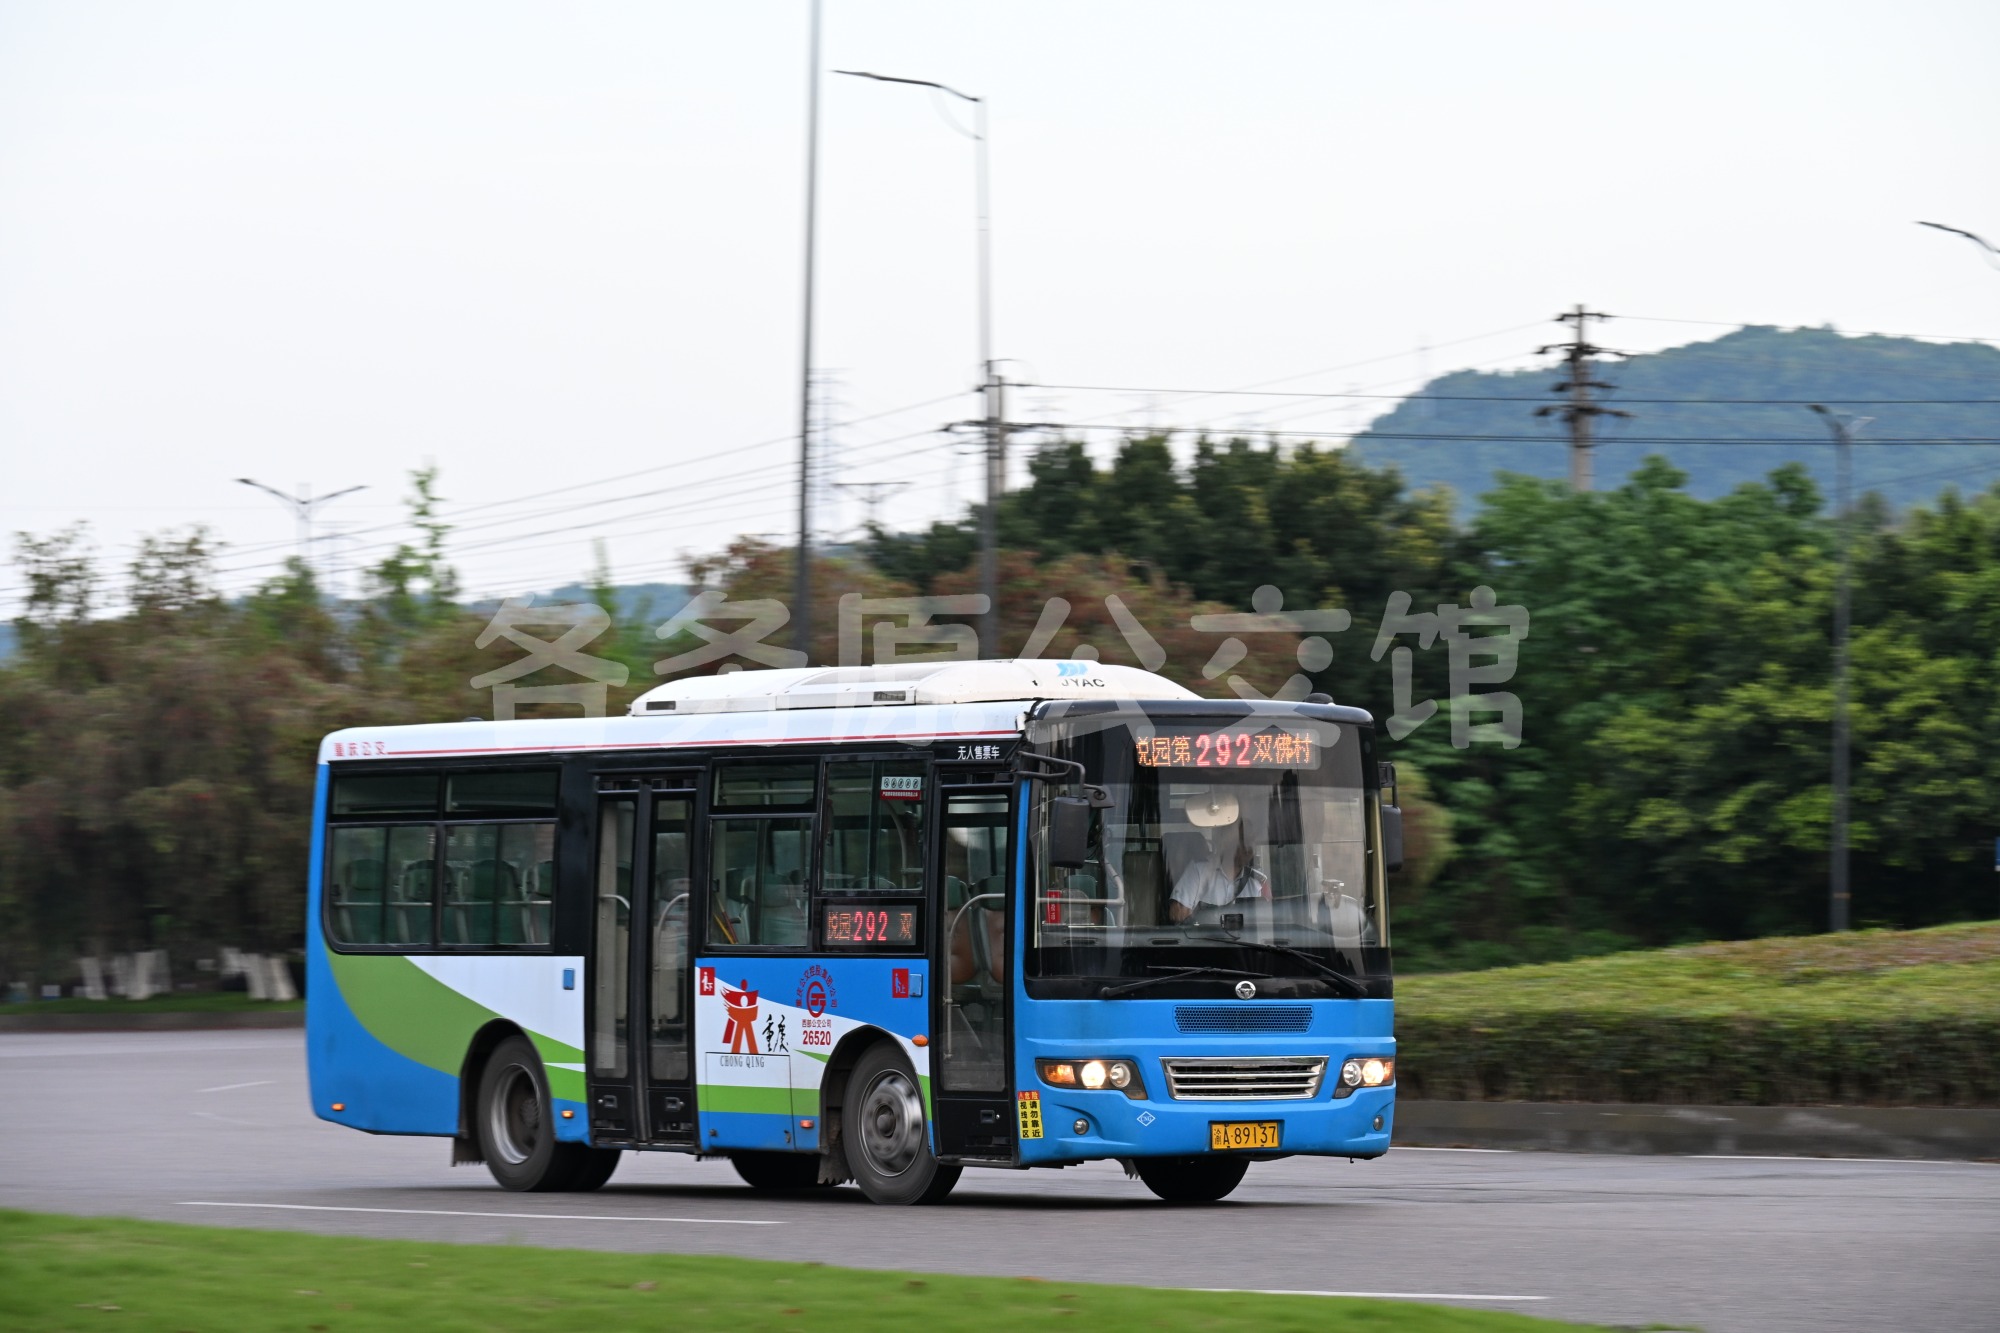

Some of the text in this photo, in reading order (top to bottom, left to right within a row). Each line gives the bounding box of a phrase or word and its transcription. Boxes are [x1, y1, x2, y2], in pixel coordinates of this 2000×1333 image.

[1061, 678, 1105, 687] JYAC
[957, 745, 1000, 760] 无人售票车
[1195, 733, 1251, 766] 292
[853, 911, 888, 942] 292
[802, 1030, 831, 1046] 26520
[720, 1056, 765, 1069] CHONG QING
